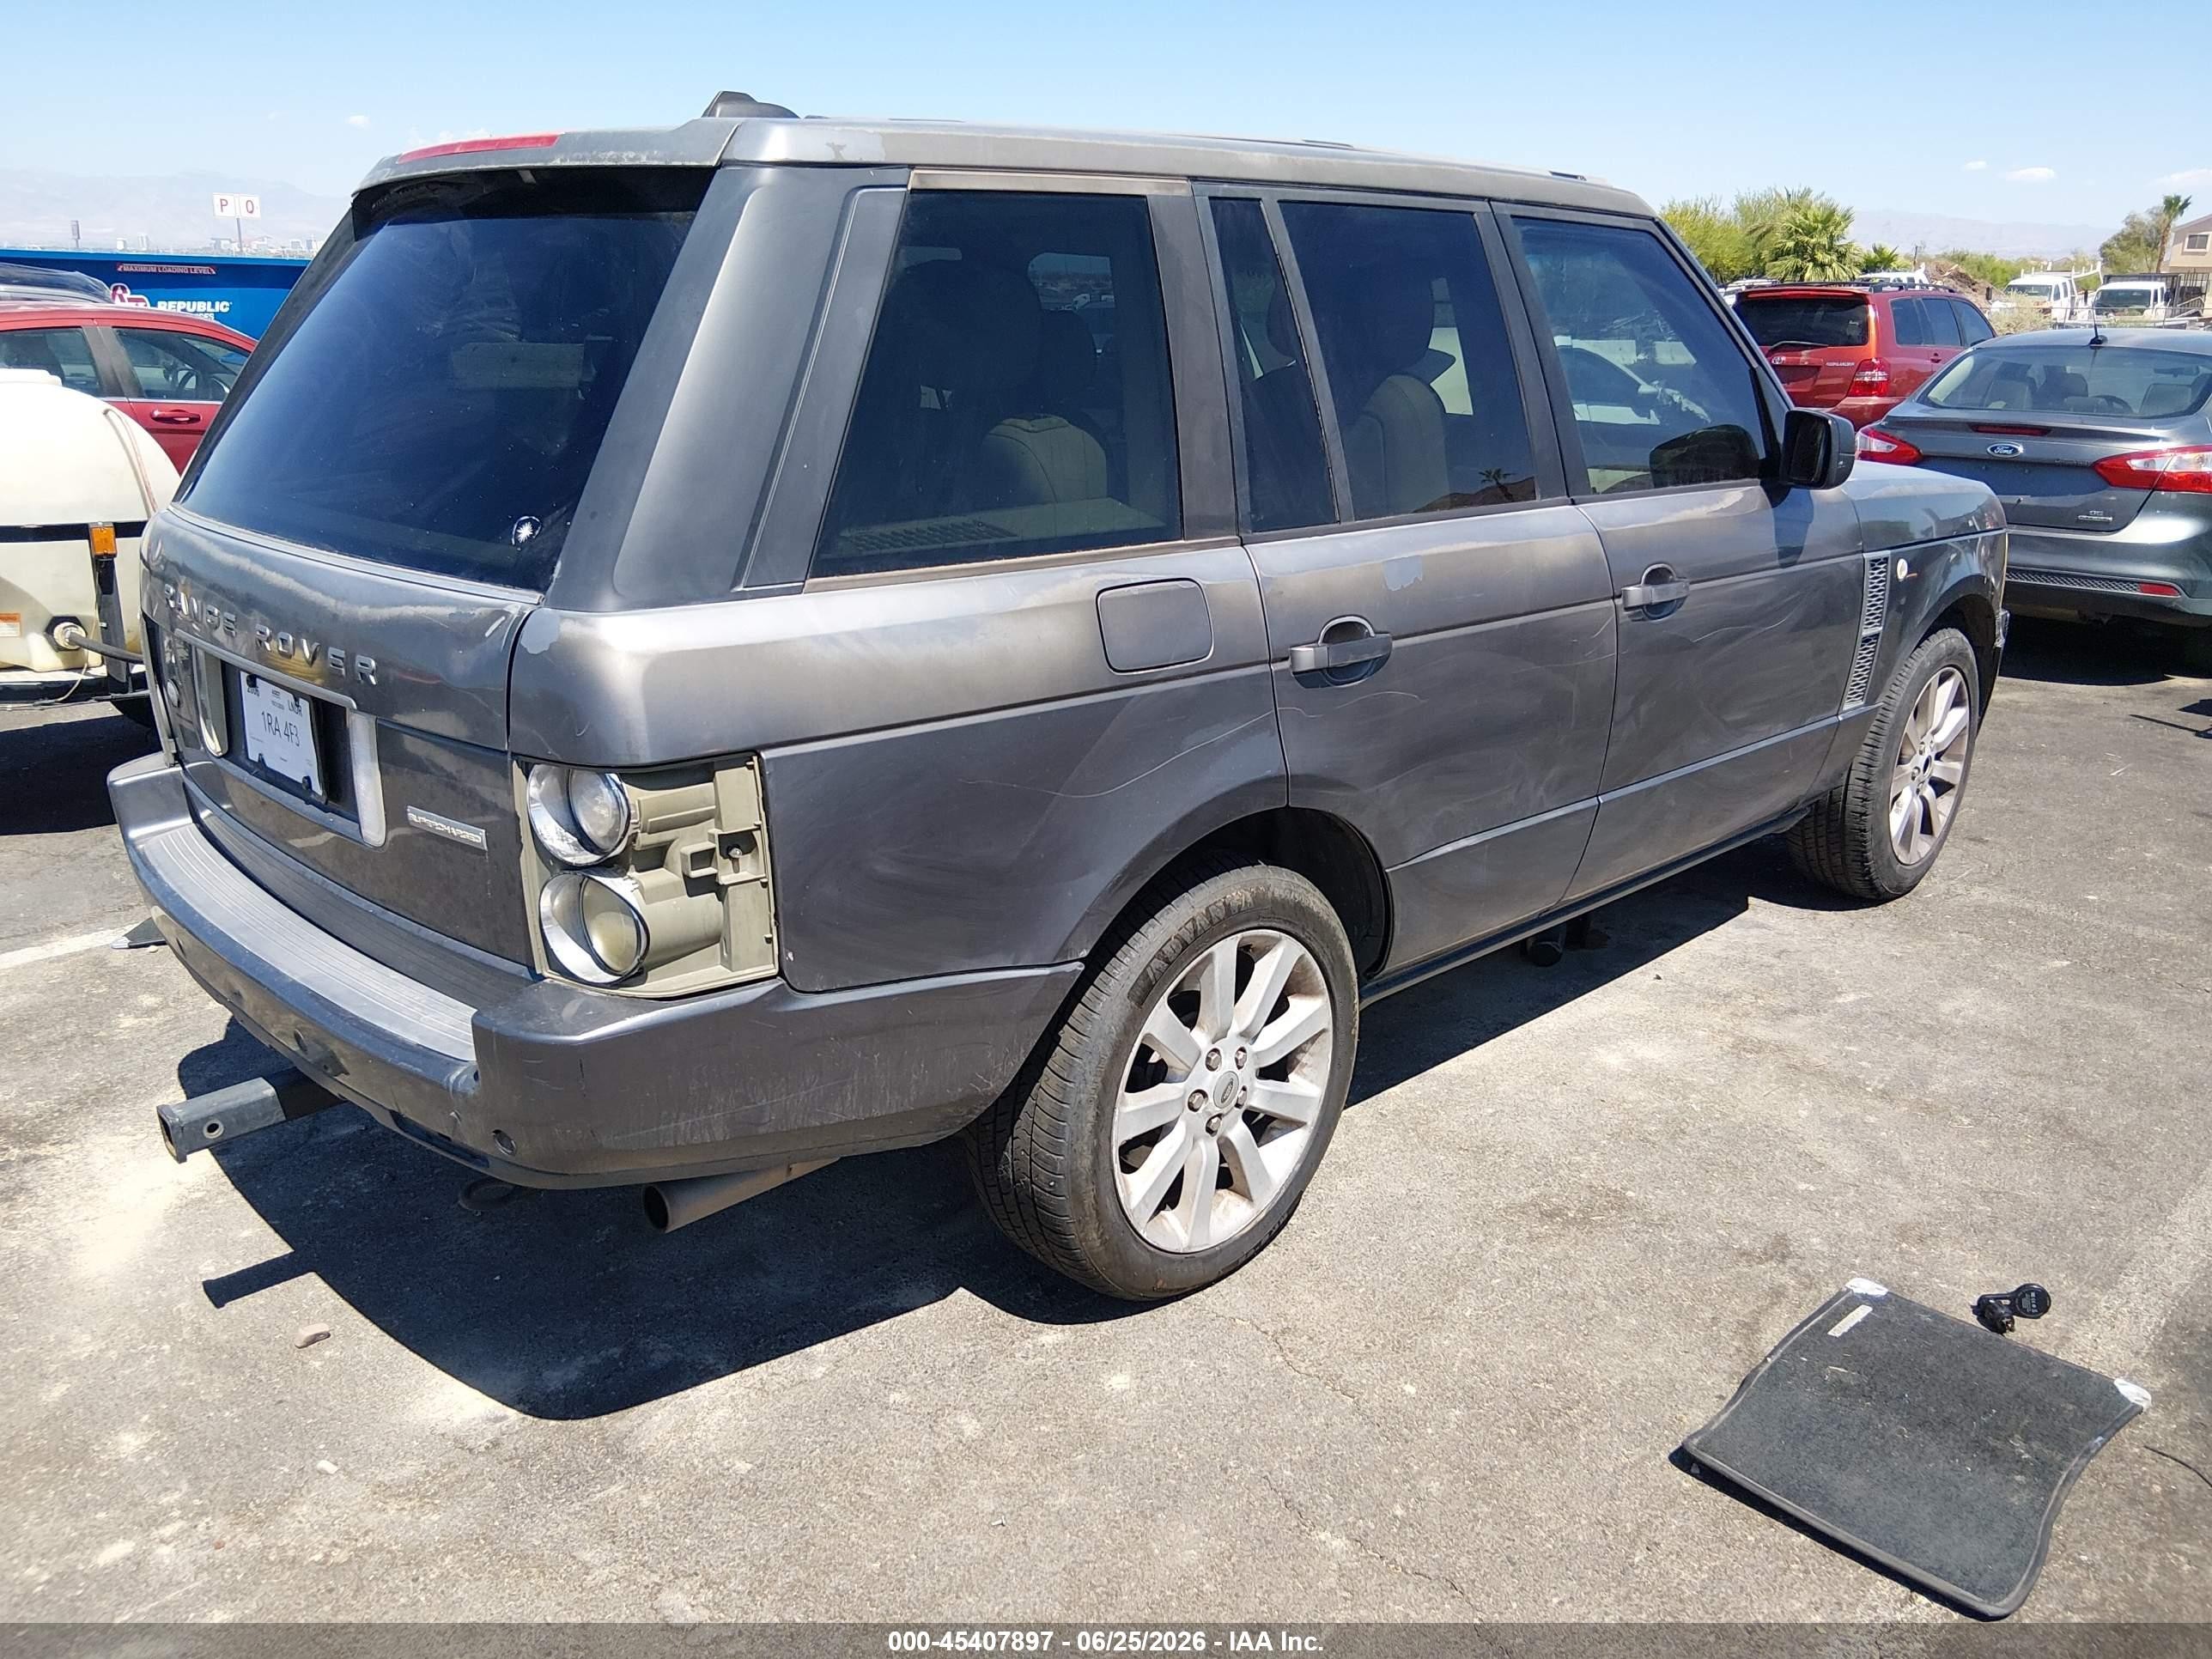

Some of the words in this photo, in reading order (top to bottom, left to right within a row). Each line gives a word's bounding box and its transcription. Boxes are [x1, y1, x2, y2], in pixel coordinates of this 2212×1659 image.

[220, 198, 228, 213] P
[157, 301, 230, 313] REPUBLIC
[1994, 444, 2014, 454] Ford
[164, 583, 237, 638] RANGE
[255, 623, 376, 685] ROVER
[261, 710, 282, 738] 1RA
[283, 720, 301, 747] 4F3
